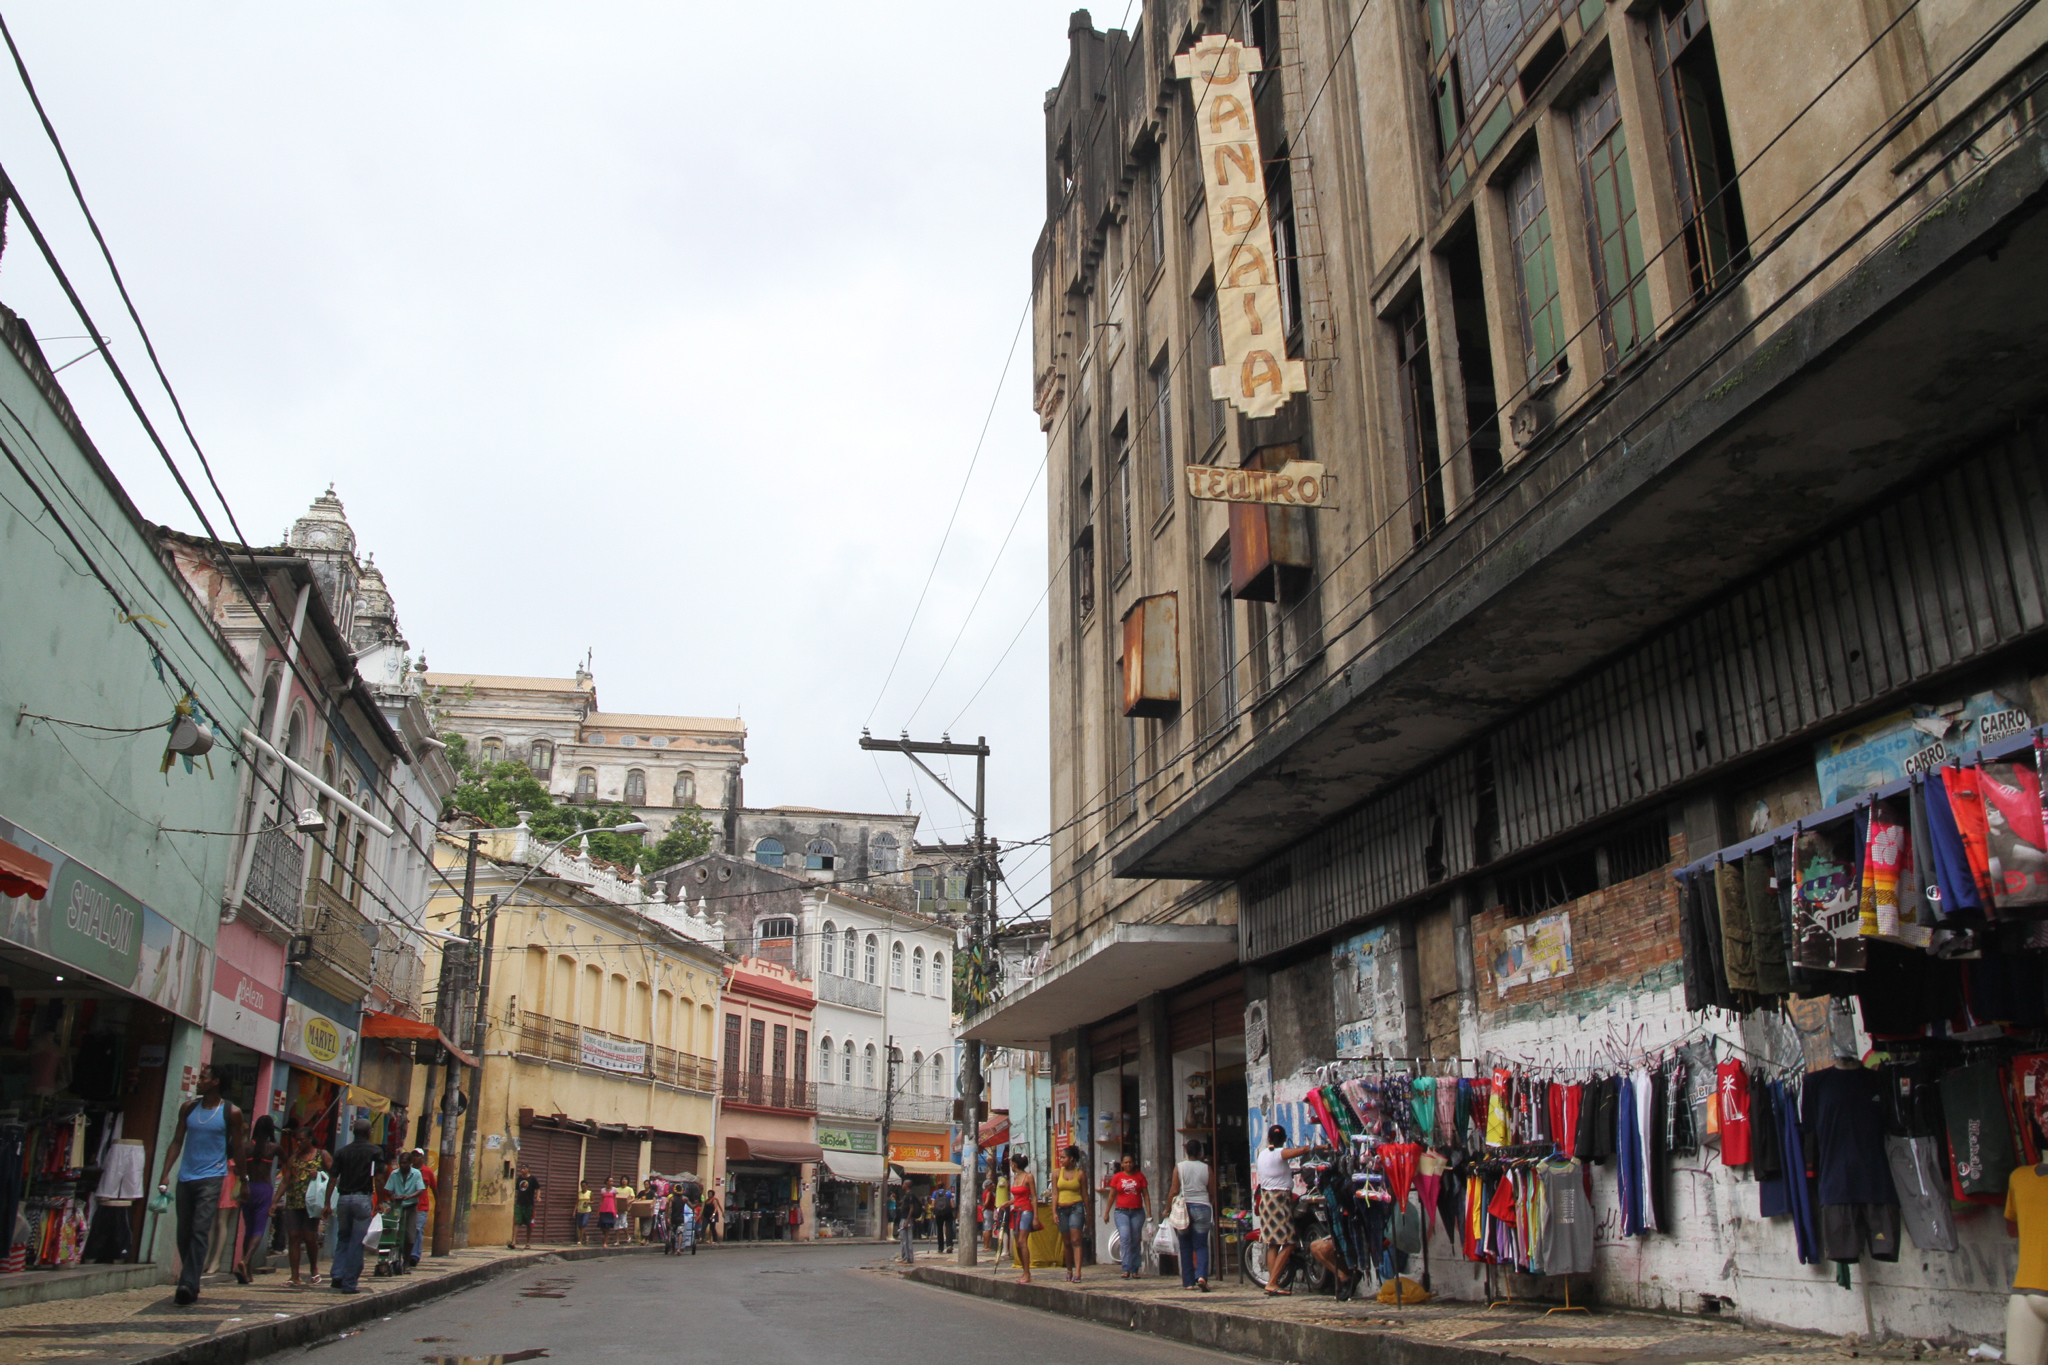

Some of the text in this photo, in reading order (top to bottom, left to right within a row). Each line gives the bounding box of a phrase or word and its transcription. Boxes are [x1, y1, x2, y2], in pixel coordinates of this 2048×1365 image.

[1195, 46, 1282, 398] JANDAIA
[1980, 708, 2026, 735] CARRO
[1824, 738, 1907, 777] ANTONIO
[1905, 742, 1945, 775] CARRO
[67, 879, 134, 956] SHALOM
[240, 976, 264, 1010] Beleza
[307, 1024, 336, 1054] MARVEL
